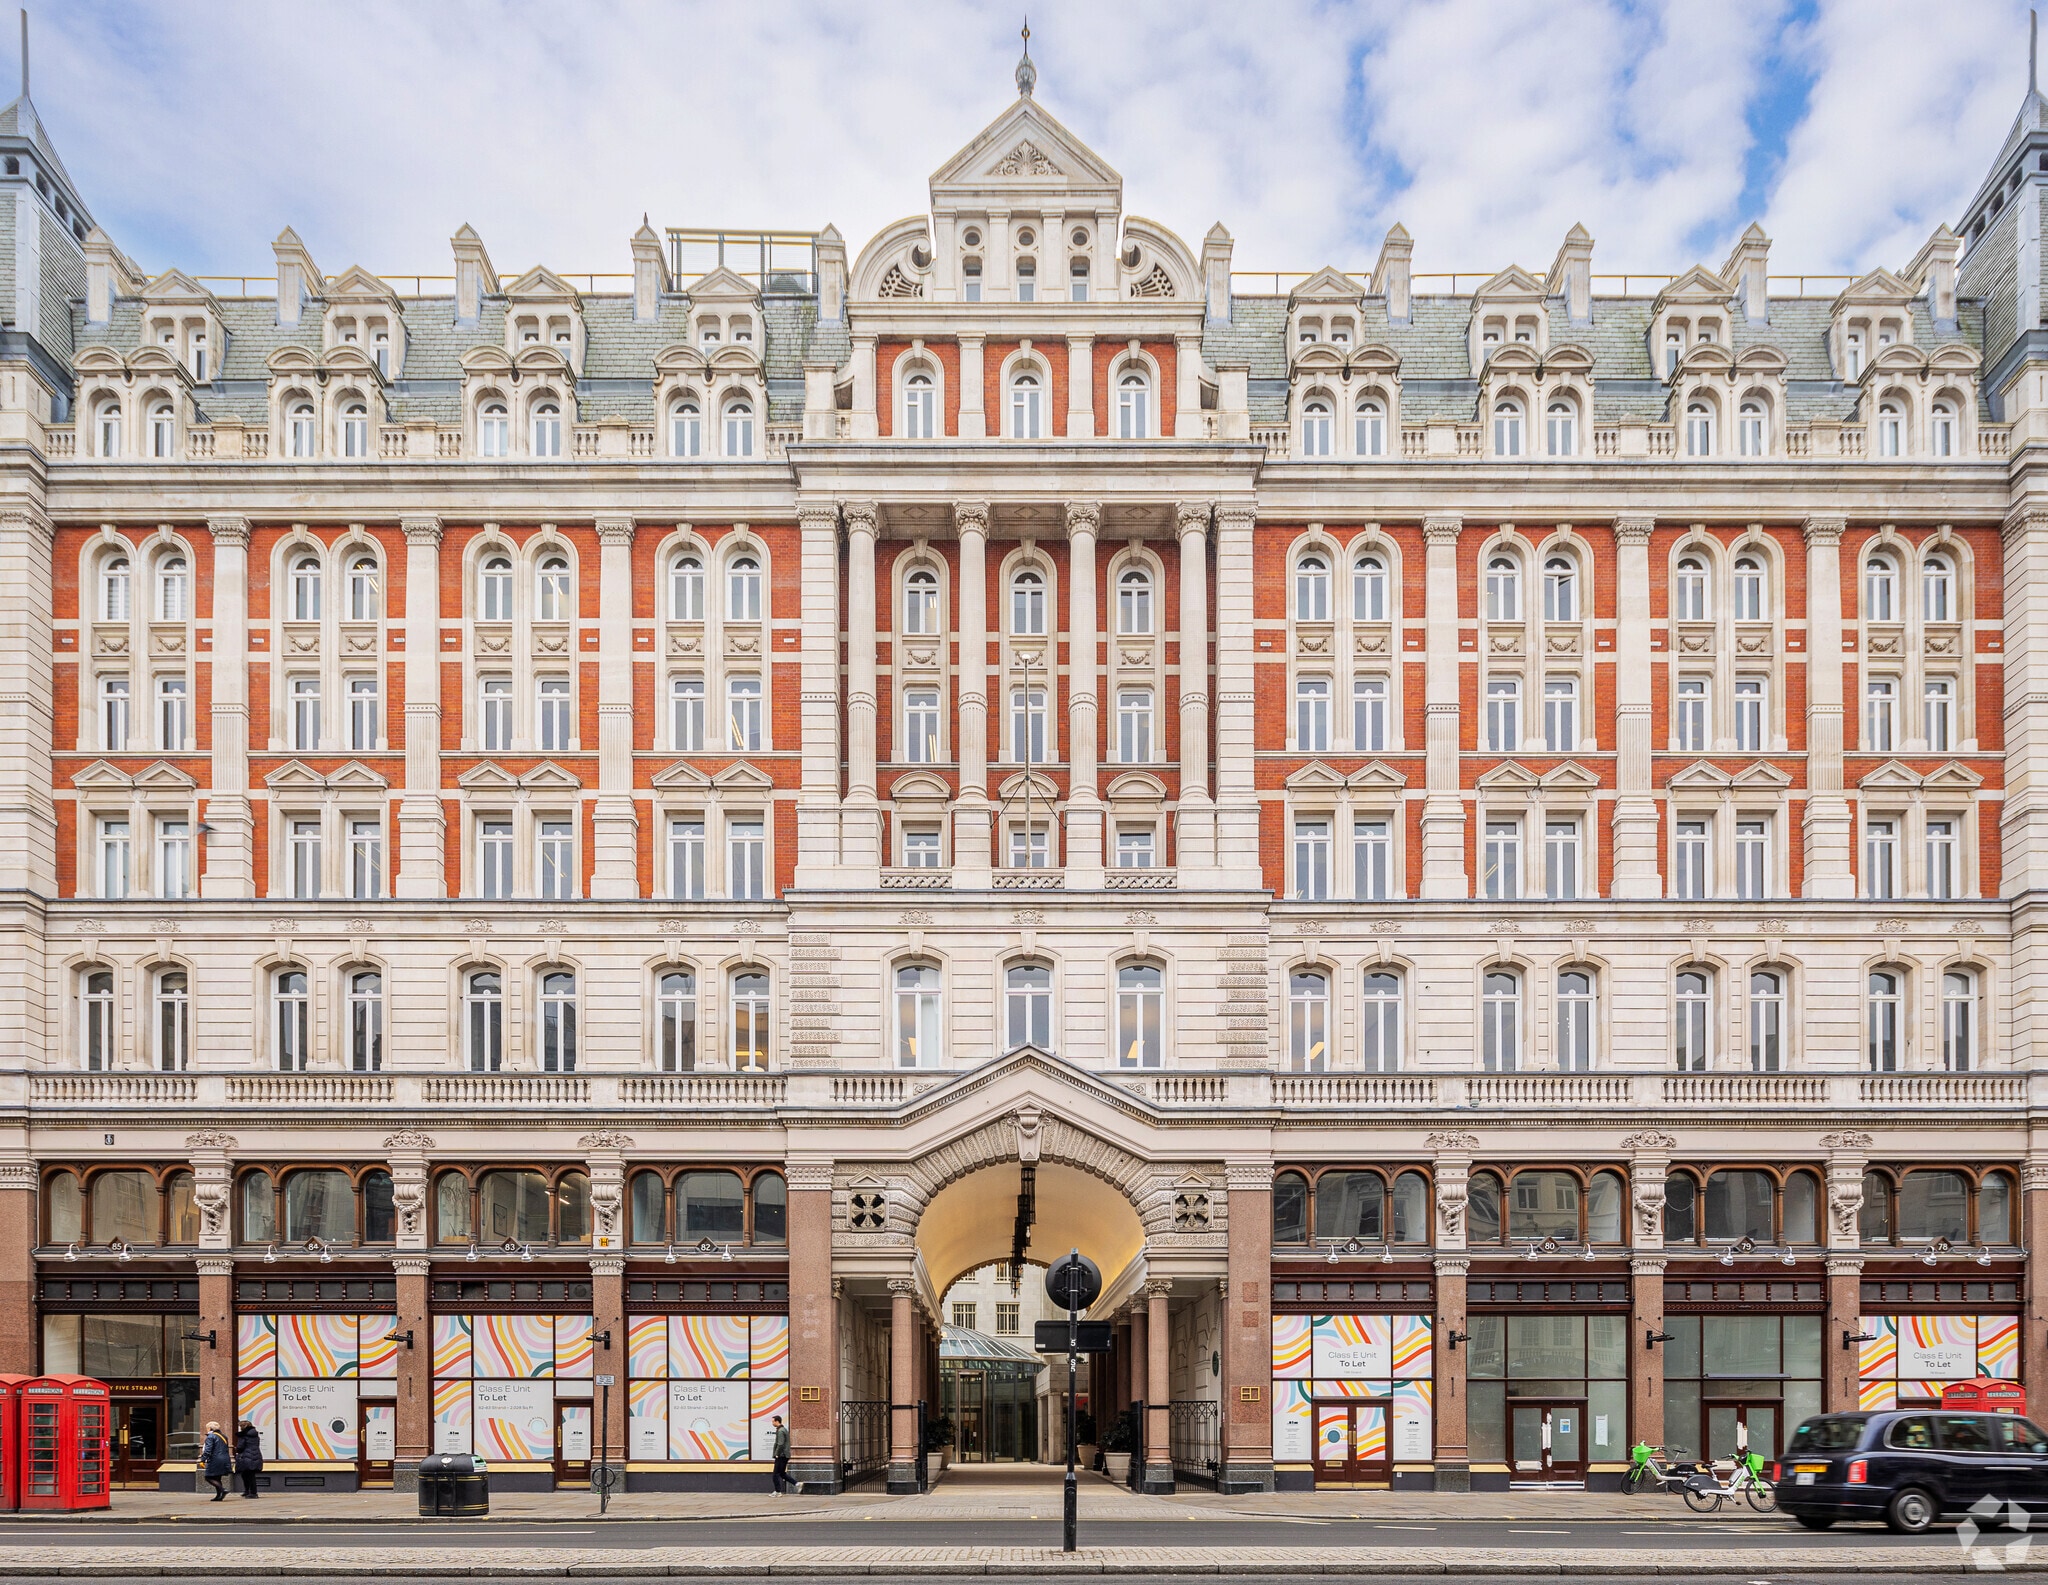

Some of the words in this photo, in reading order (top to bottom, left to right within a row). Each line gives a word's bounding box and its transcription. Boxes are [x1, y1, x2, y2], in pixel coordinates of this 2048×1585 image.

[112, 1243, 121, 1251] 85
[309, 1243, 319, 1251] 84
[505, 1243, 515, 1251] 83
[701, 1243, 711, 1251] 82
[1349, 1243, 1357, 1251] 81
[1938, 1243, 1948, 1251] 78
[1328, 1351, 1351, 1359] Class
[1353, 1351, 1358, 1359] E
[1361, 1351, 1377, 1359] Unit
